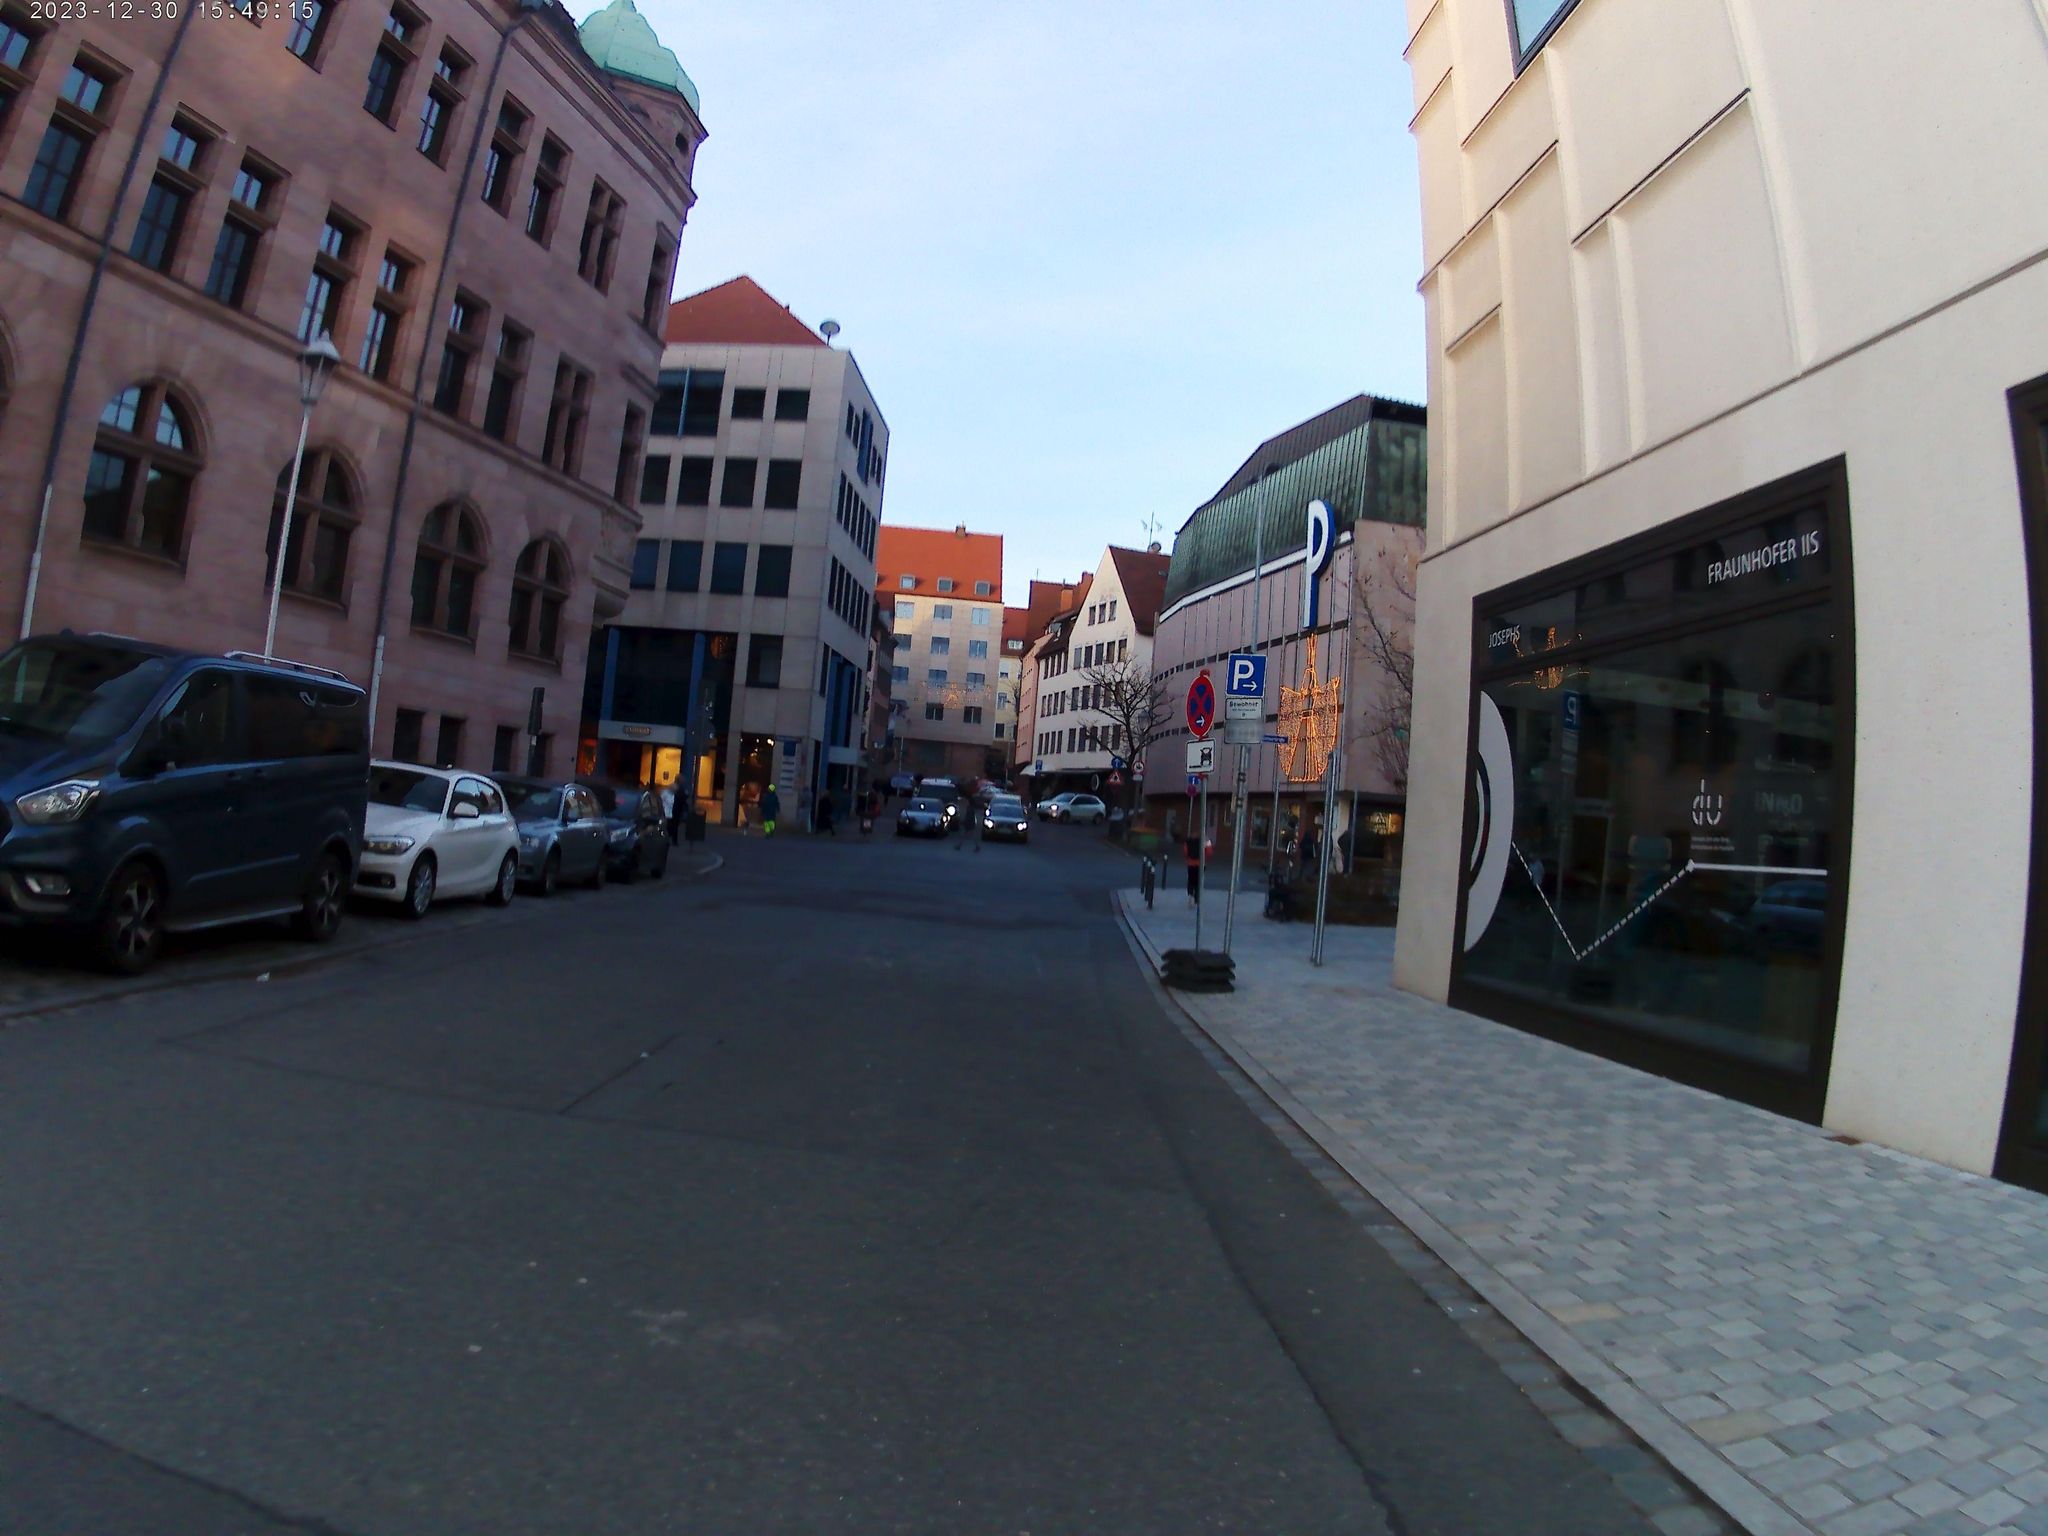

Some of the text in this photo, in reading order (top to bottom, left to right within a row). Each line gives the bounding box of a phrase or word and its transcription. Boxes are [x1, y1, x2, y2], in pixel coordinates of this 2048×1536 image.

[1707, 530, 1820, 585] FRAUNHOFER IIS
[1488, 623, 1521, 649] JOSEPHS
[1232, 659, 1255, 691] P
